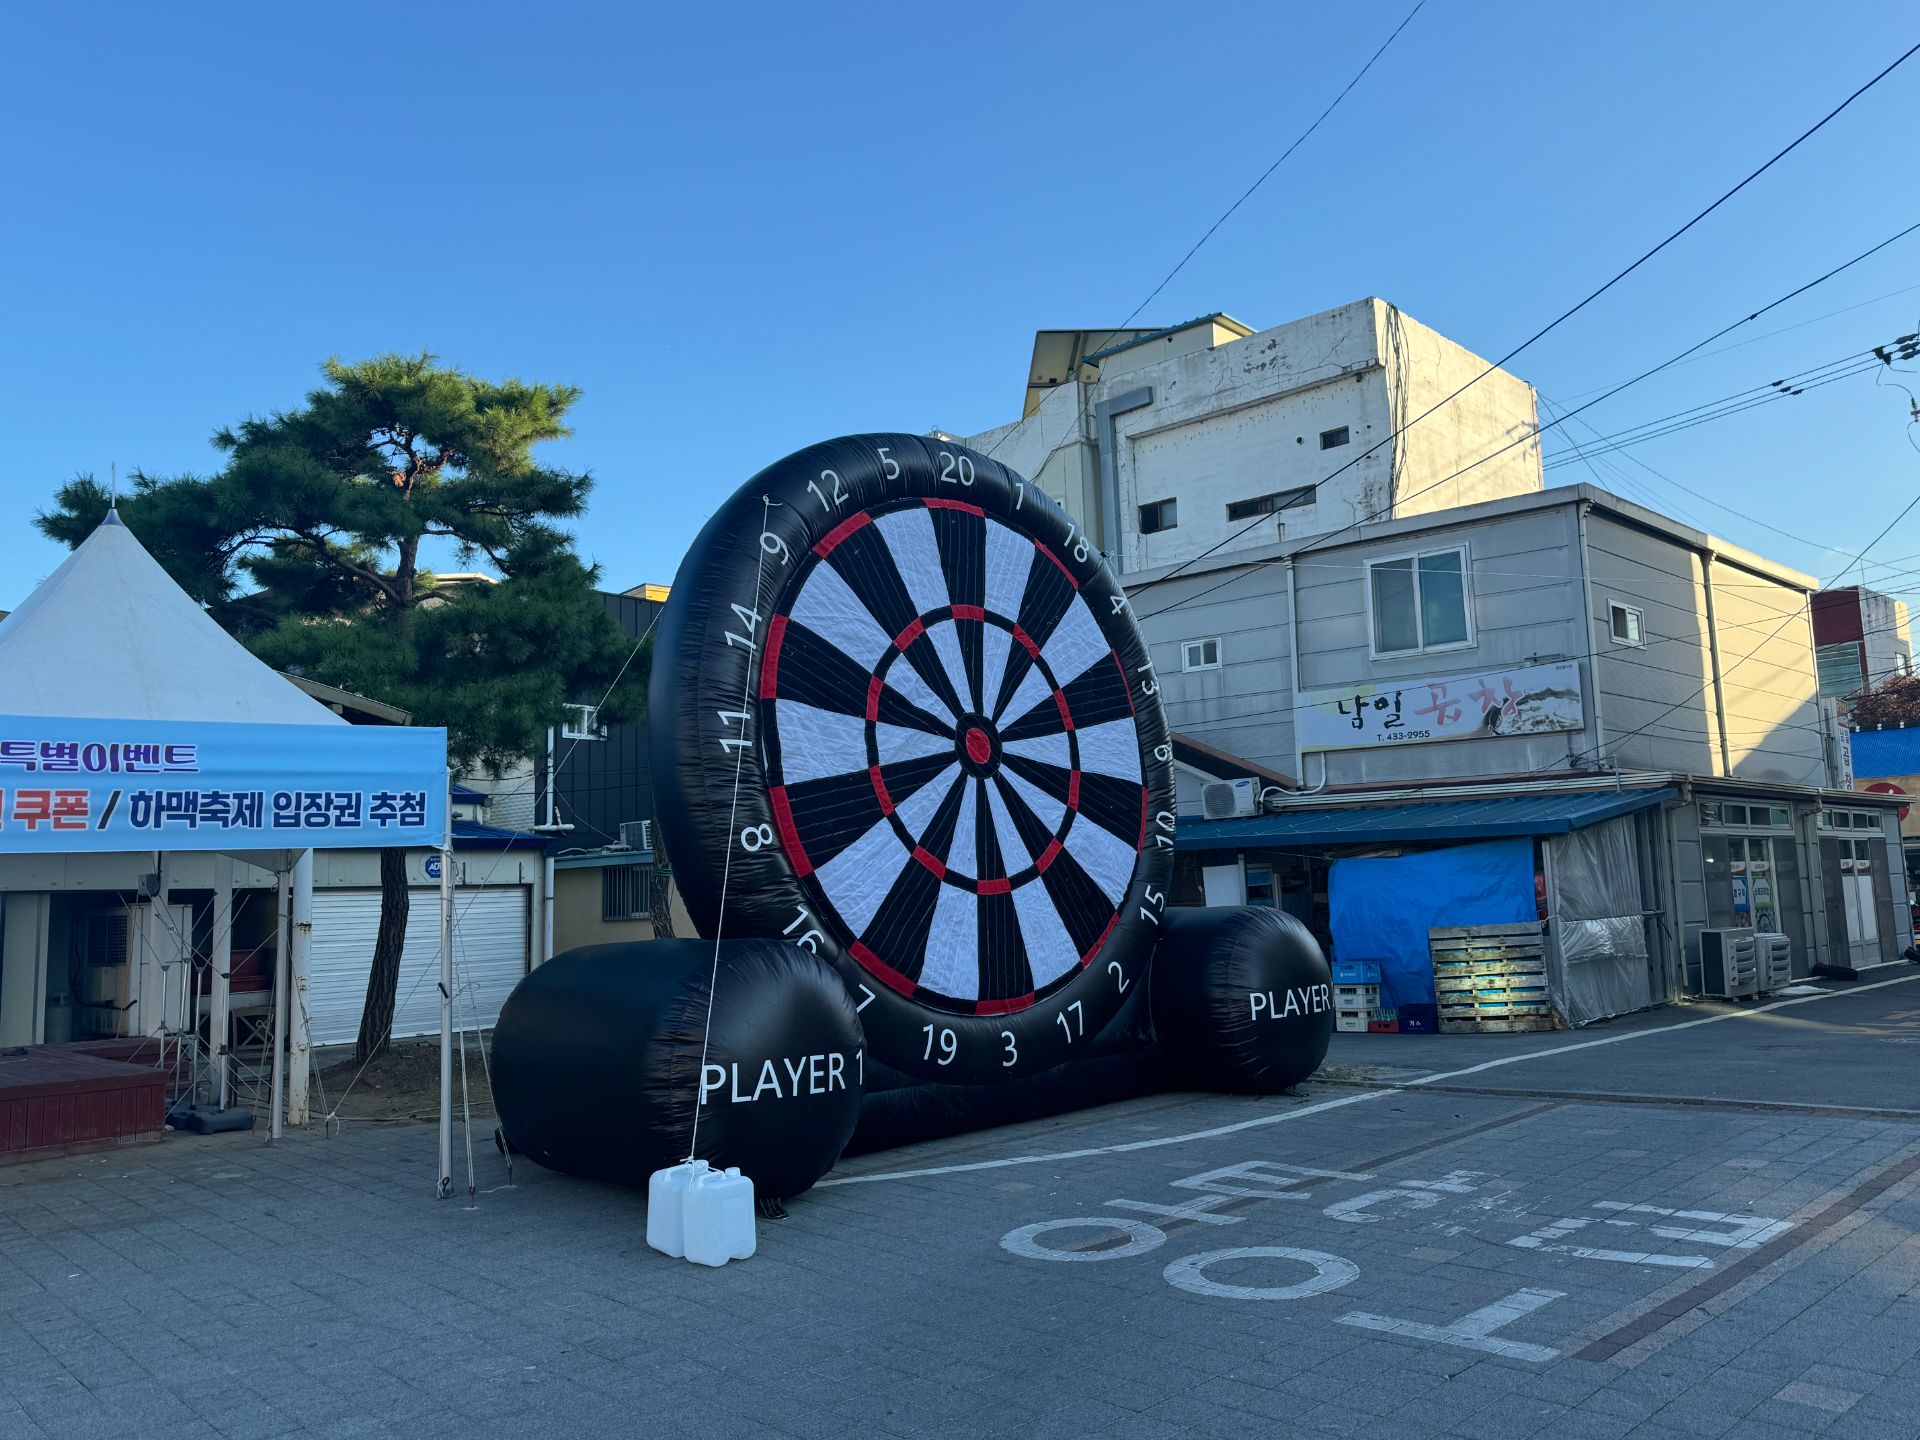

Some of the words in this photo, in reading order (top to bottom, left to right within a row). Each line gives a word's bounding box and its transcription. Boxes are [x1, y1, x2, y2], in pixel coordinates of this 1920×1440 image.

[877, 447, 900, 480] 5
[939, 451, 975, 486] 20
[806, 469, 849, 512] 12
[759, 532, 789, 565] 9
[1063, 522, 1090, 563] 18
[1109, 594, 1127, 615] 4
[724, 602, 763, 650] 14
[1337, 690, 1405, 729] 남일
[717, 711, 752, 753] 11
[1386, 730, 1431, 741] 433-2955
[0, 741, 199, 773] 특별이벤트
[14, 790, 89, 830] 쿠폰
[130, 790, 263, 829] 하맥축제
[273, 791, 362, 828] 입장권
[369, 791, 426, 828] 추첨
[740, 823, 773, 852] 8
[1140, 885, 1164, 925] 15
[1107, 961, 1130, 994] 2
[1249, 984, 1331, 1020] PLAYER
[1056, 999, 1083, 1044] 17
[922, 1023, 957, 1066] 19
[1001, 1030, 1018, 1067] 3
[700, 1052, 846, 1105] PLAYER
[855, 1048, 863, 1086] 1
